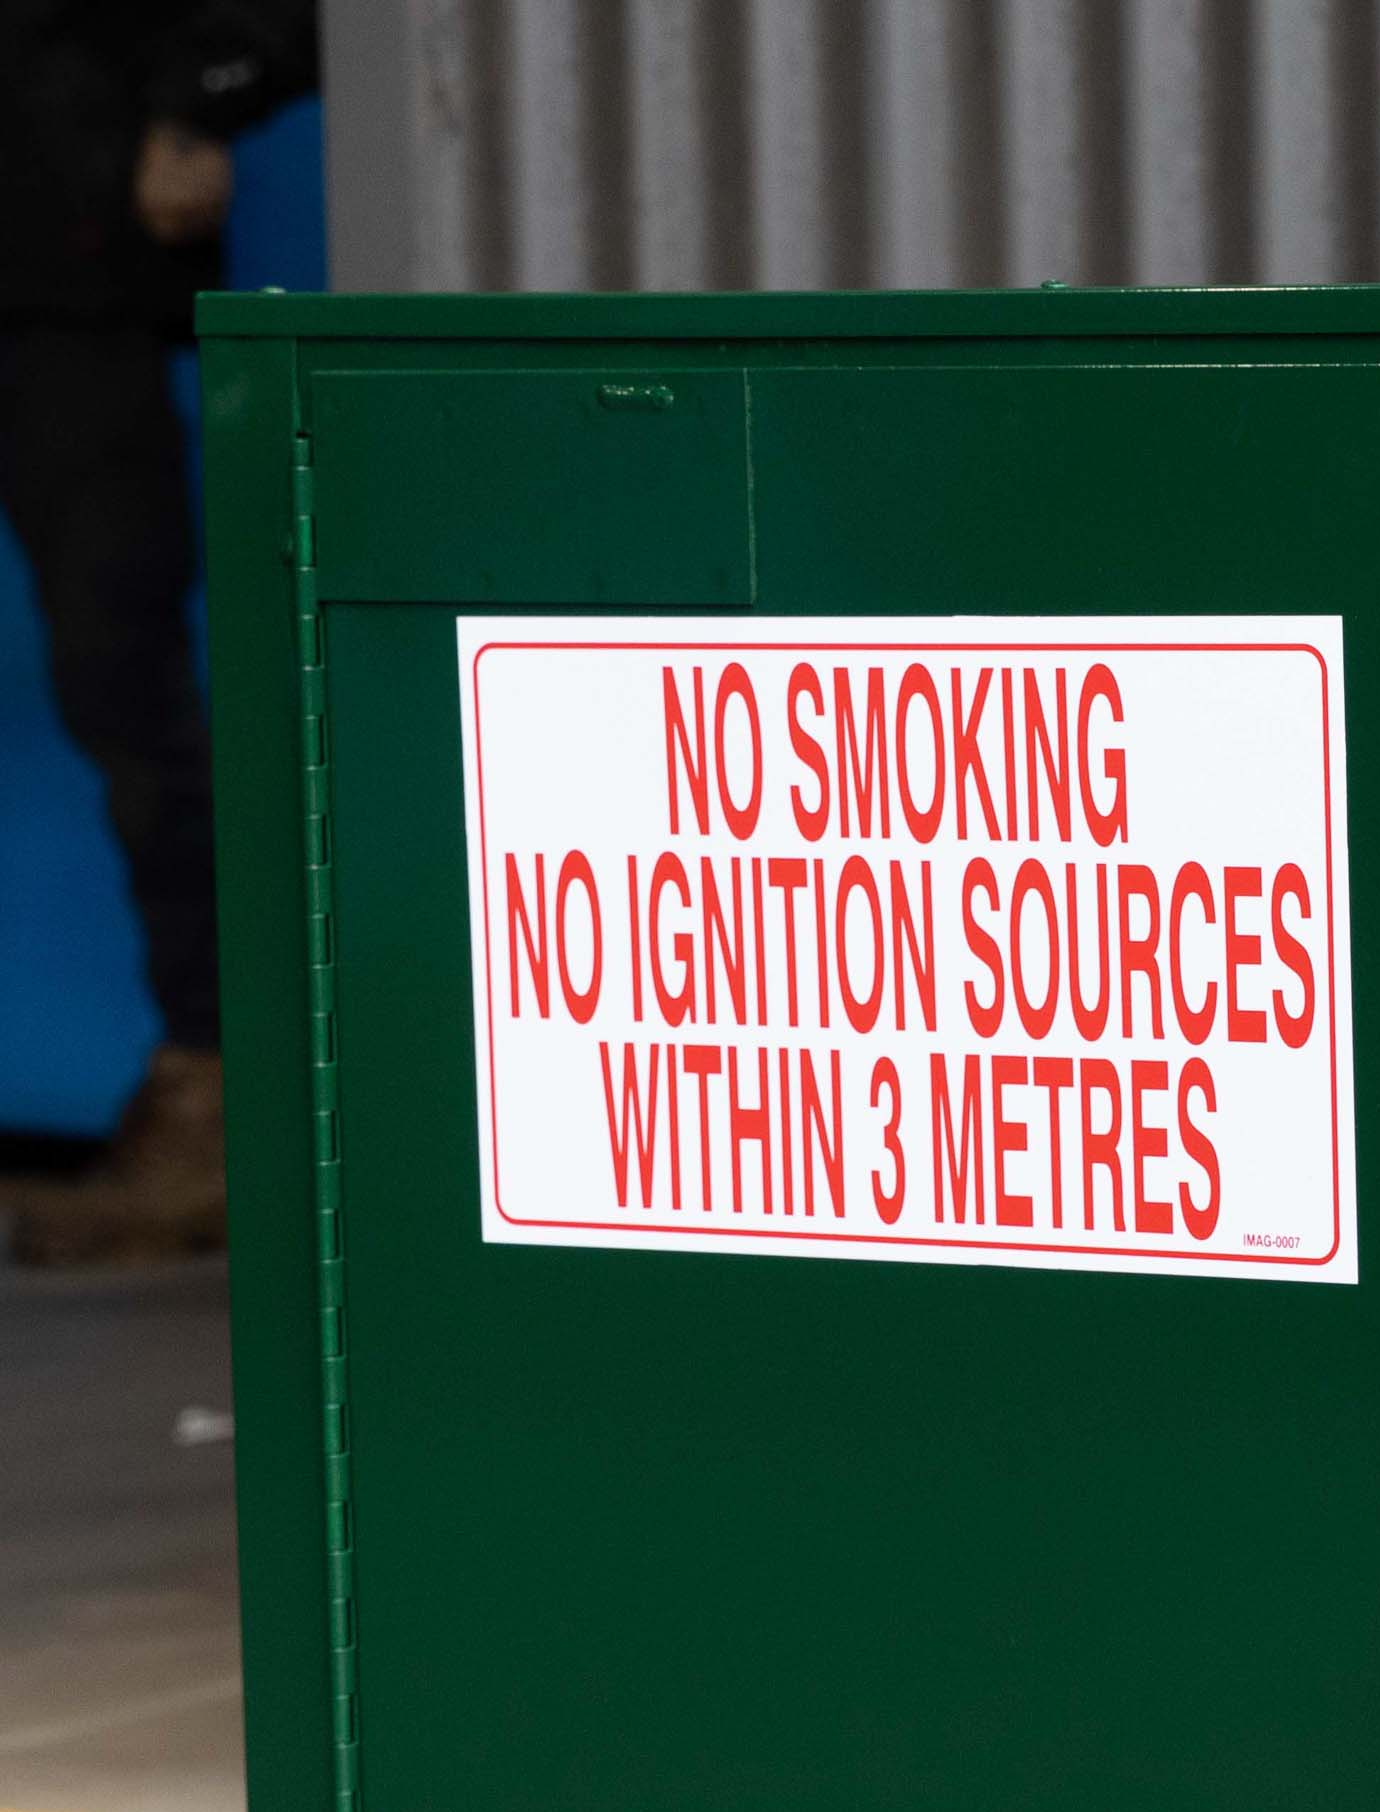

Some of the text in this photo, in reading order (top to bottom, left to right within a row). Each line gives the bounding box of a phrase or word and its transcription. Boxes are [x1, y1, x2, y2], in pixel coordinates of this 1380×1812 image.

[662, 662, 1129, 847] NO SMOKING
[505, 848, 1316, 1050] NO IGNITION SOURCES
[599, 1041, 1222, 1240] WITHIN 3 METRES
[1243, 1233, 1301, 1249] IMAG-0007
